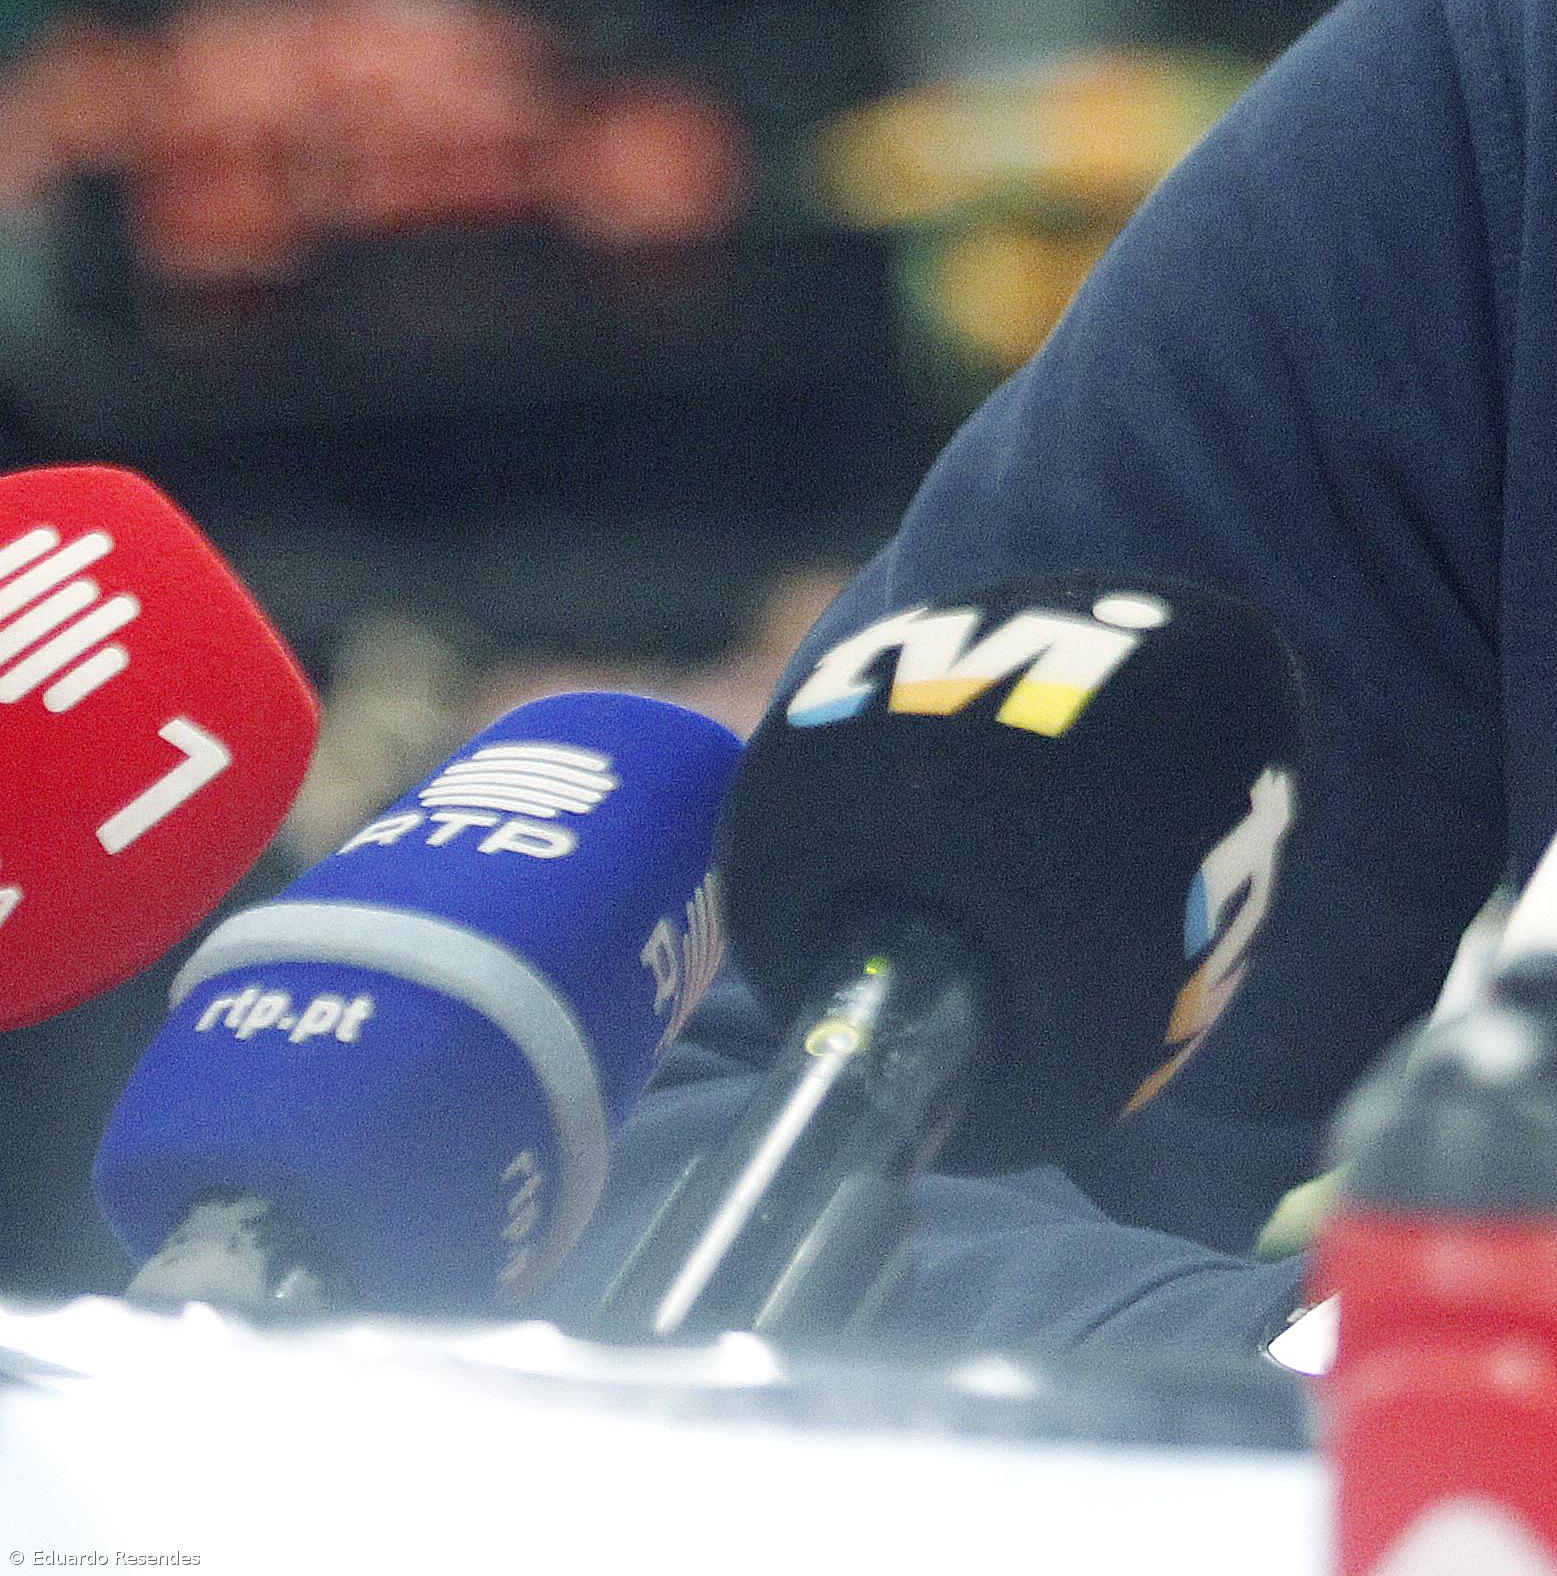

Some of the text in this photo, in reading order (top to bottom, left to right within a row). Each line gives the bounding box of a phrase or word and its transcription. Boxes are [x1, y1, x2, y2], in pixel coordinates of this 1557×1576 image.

[787, 591, 1167, 738] tvi
[336, 811, 579, 859] RTP
[196, 986, 375, 1044] rtp.pt
